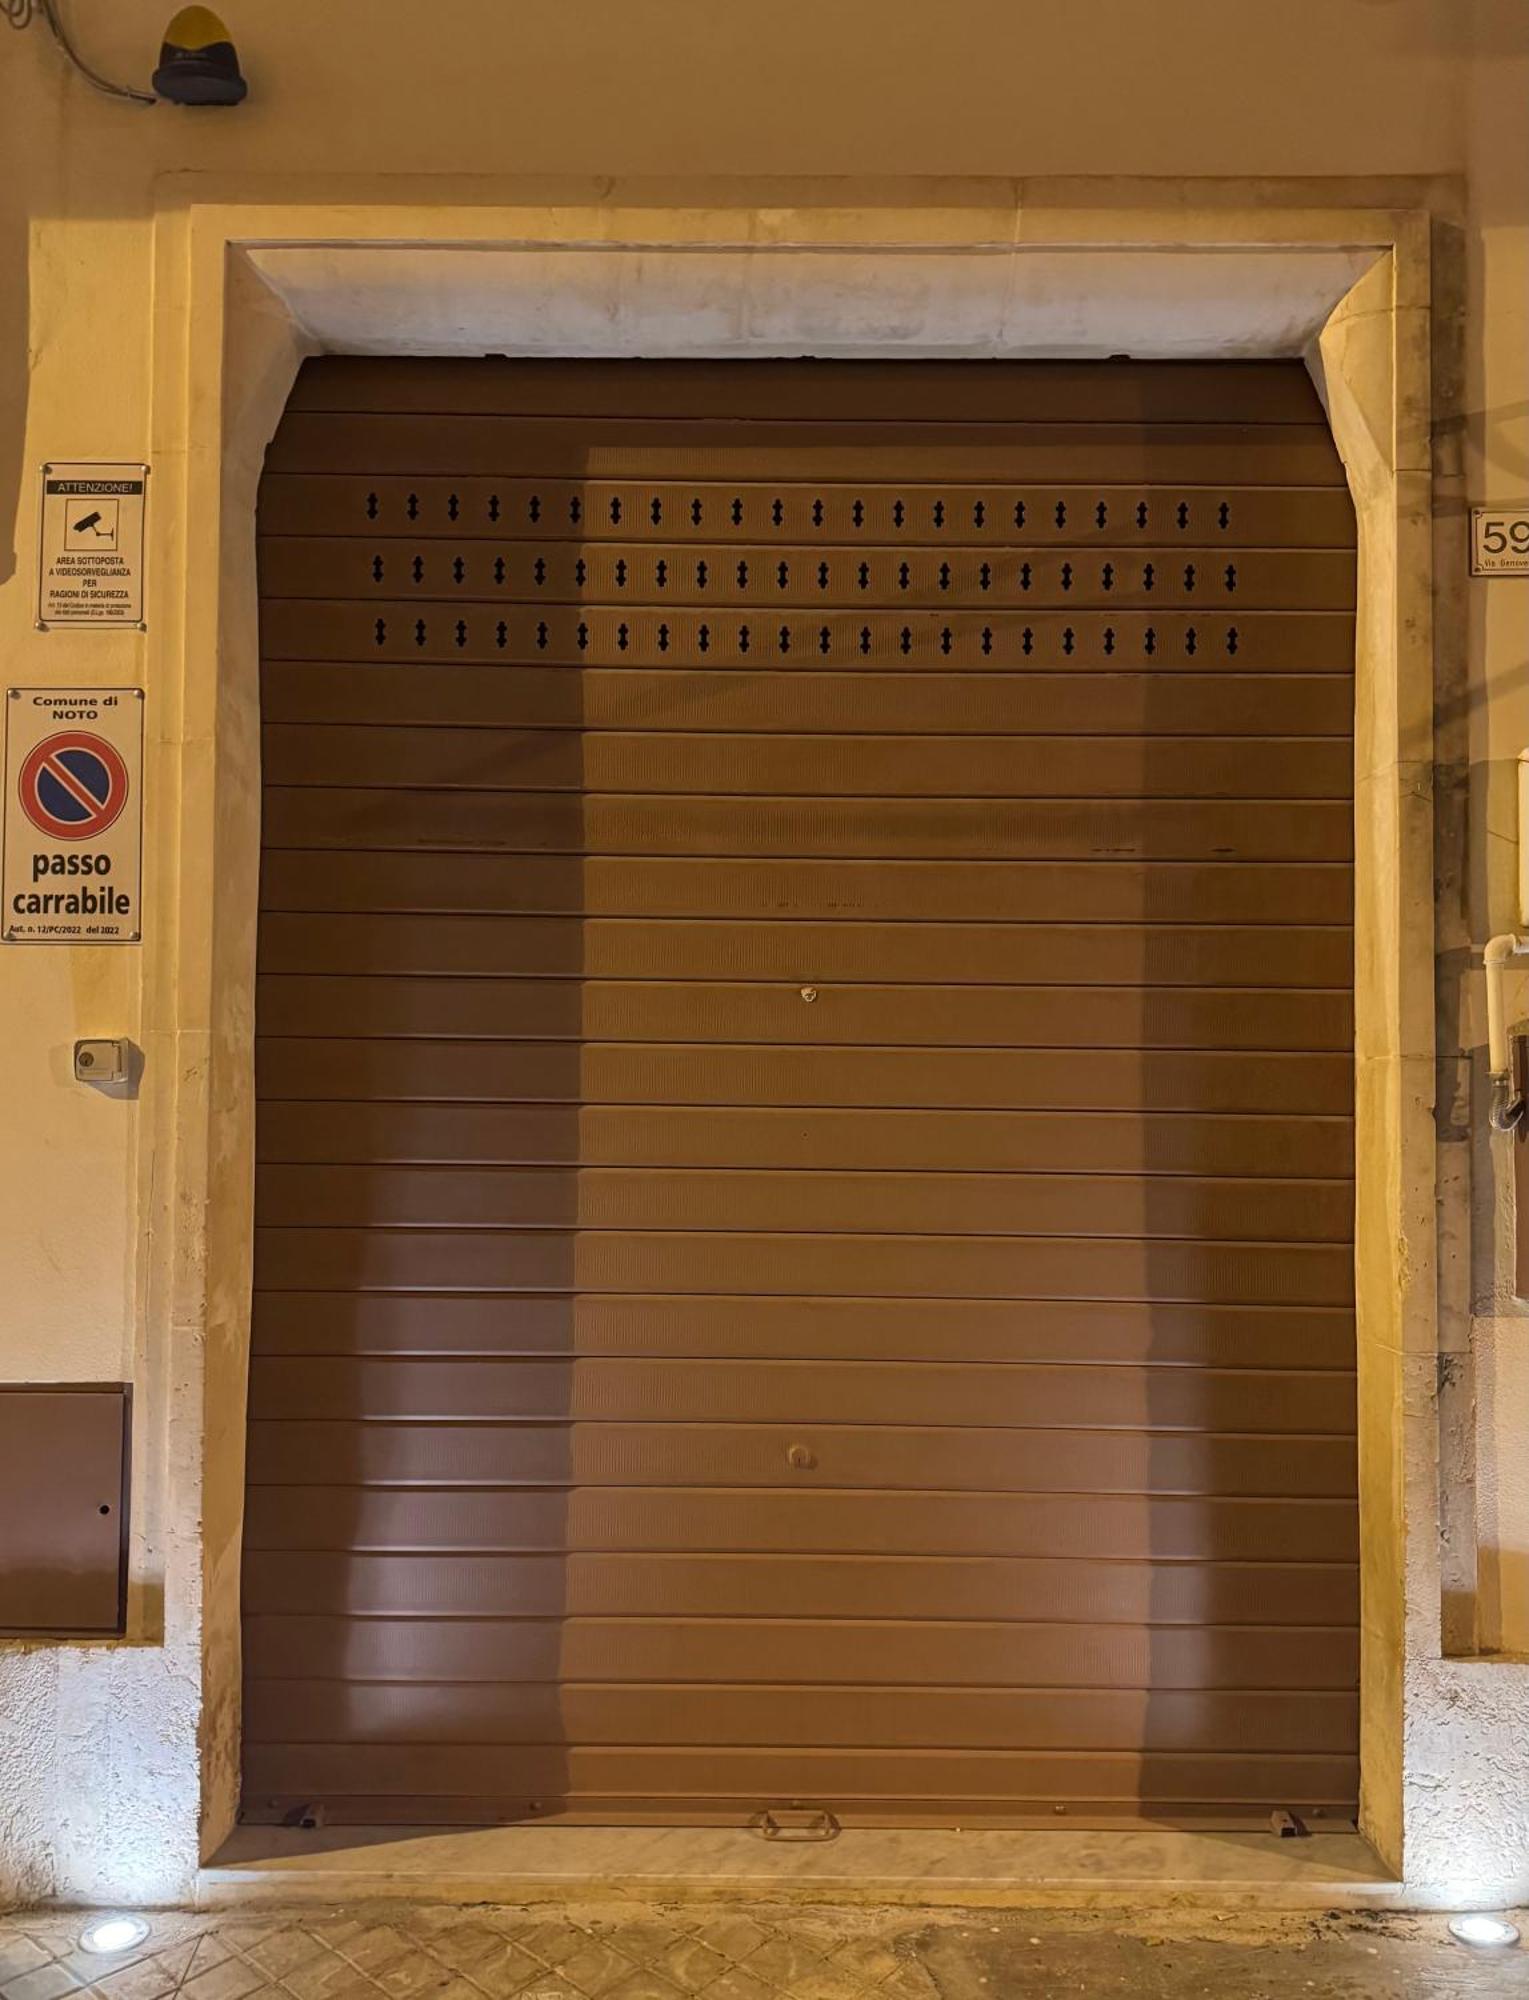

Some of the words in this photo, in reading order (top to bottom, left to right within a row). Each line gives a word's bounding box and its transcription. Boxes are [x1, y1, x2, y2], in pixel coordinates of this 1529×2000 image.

[57, 482, 133, 493] ATTENZIONE!
[1482, 521, 1529, 554] 59
[56, 556, 76, 565] AREA
[77, 556, 124, 566] SOTTOPOSTA
[49, 568, 54, 576] A
[55, 568, 131, 577] VIDEOSORVEGLIANZA
[82, 579, 97, 588] PER
[49, 590, 80, 599] RAGIONI
[81, 590, 89, 599] DI
[90, 590, 129, 599] SICUREZZA
[32, 696, 98, 707] Comune
[102, 696, 118, 706] di
[52, 710, 98, 720] NOTO
[32, 853, 111, 883] passo
[12, 886, 130, 915] carrabile
[37, 925, 81, 935] 12/PC/2022
[86, 925, 99, 934] del
[100, 926, 119, 935] 2022
